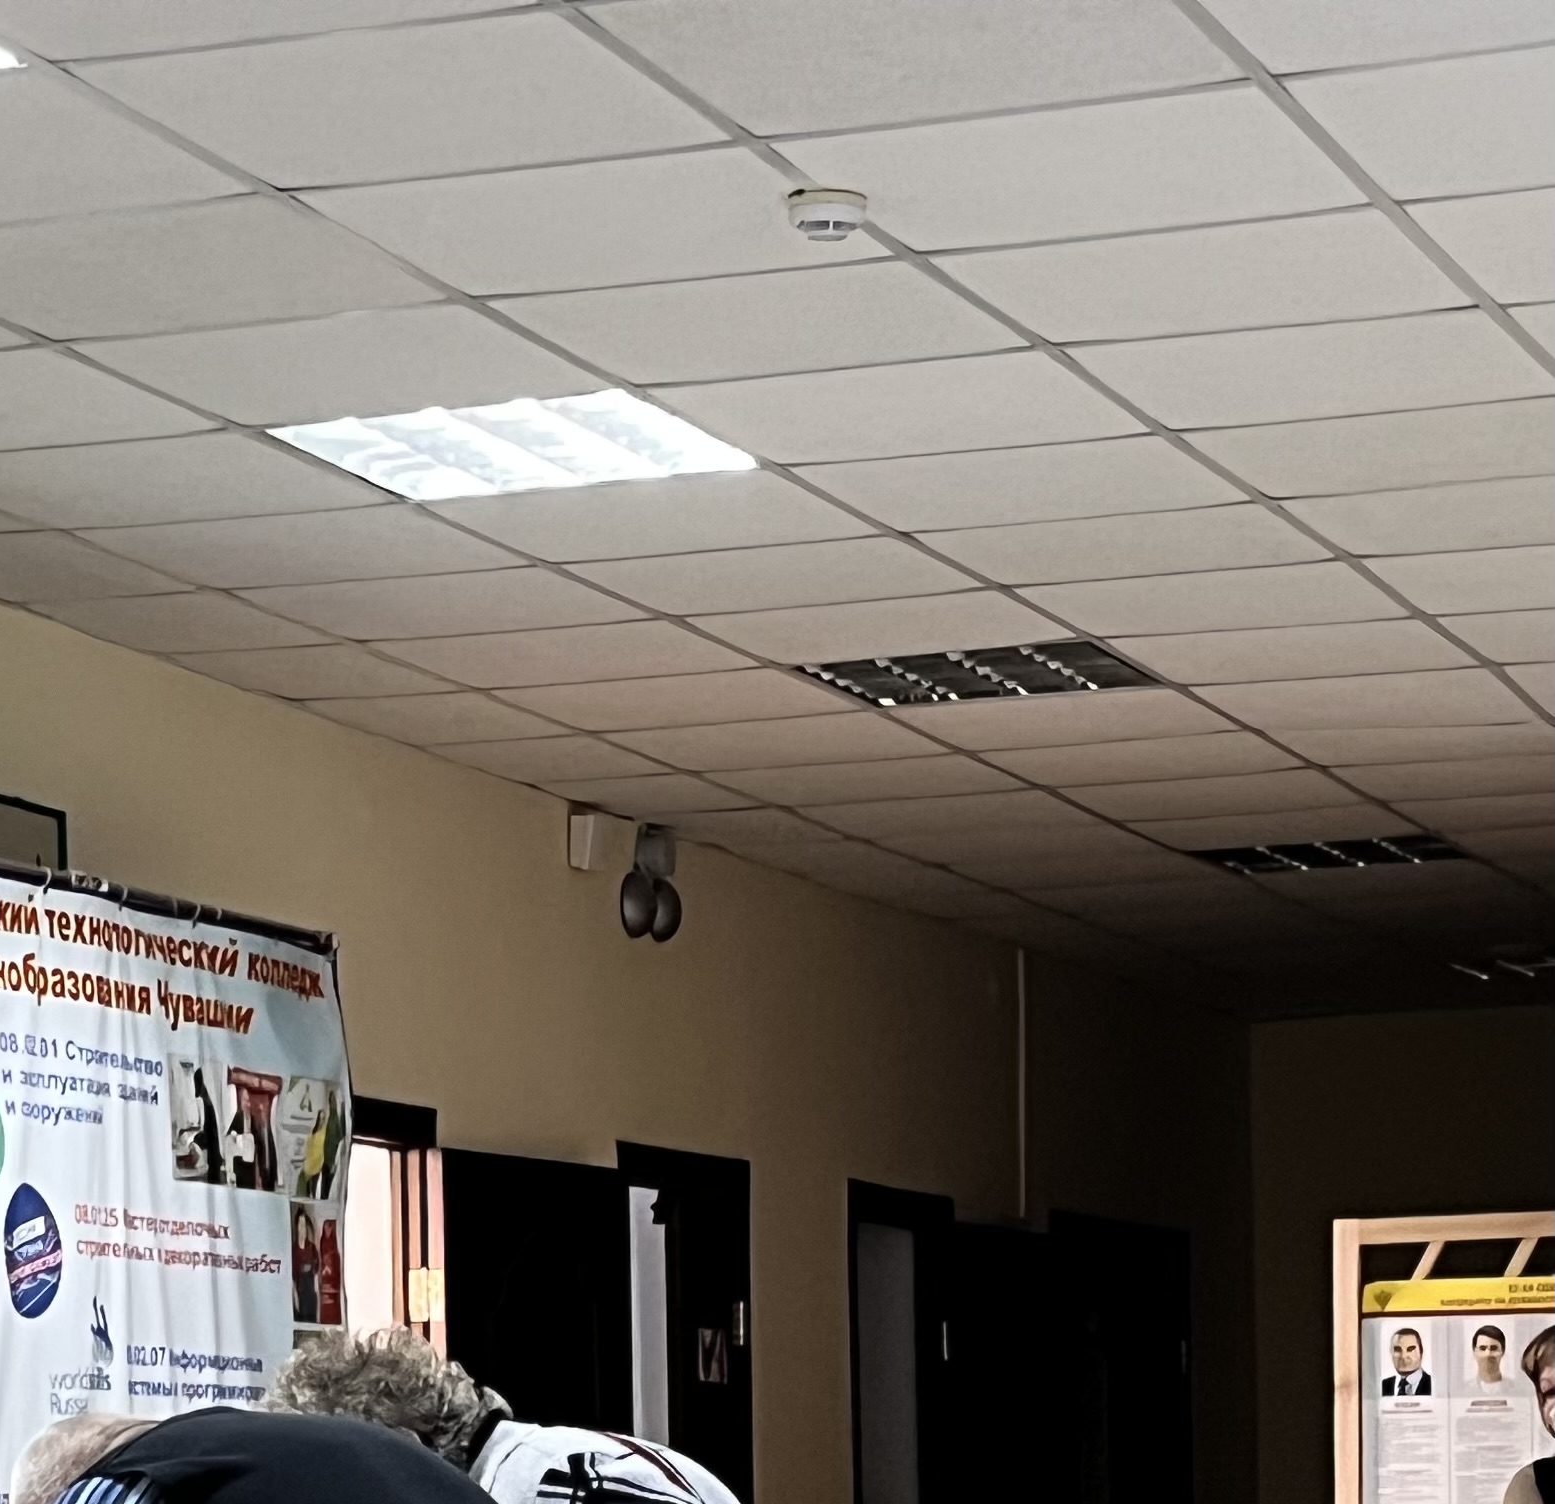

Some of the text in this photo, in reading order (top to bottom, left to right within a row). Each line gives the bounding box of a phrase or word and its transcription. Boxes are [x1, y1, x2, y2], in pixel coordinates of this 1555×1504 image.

[44, 905, 240, 978] технологический
[247, 951, 326, 1001] колледж
[156, 978, 255, 1035] Чувашии
[2, 1069, 12, 1083] и
[5, 1100, 16, 1115] и
